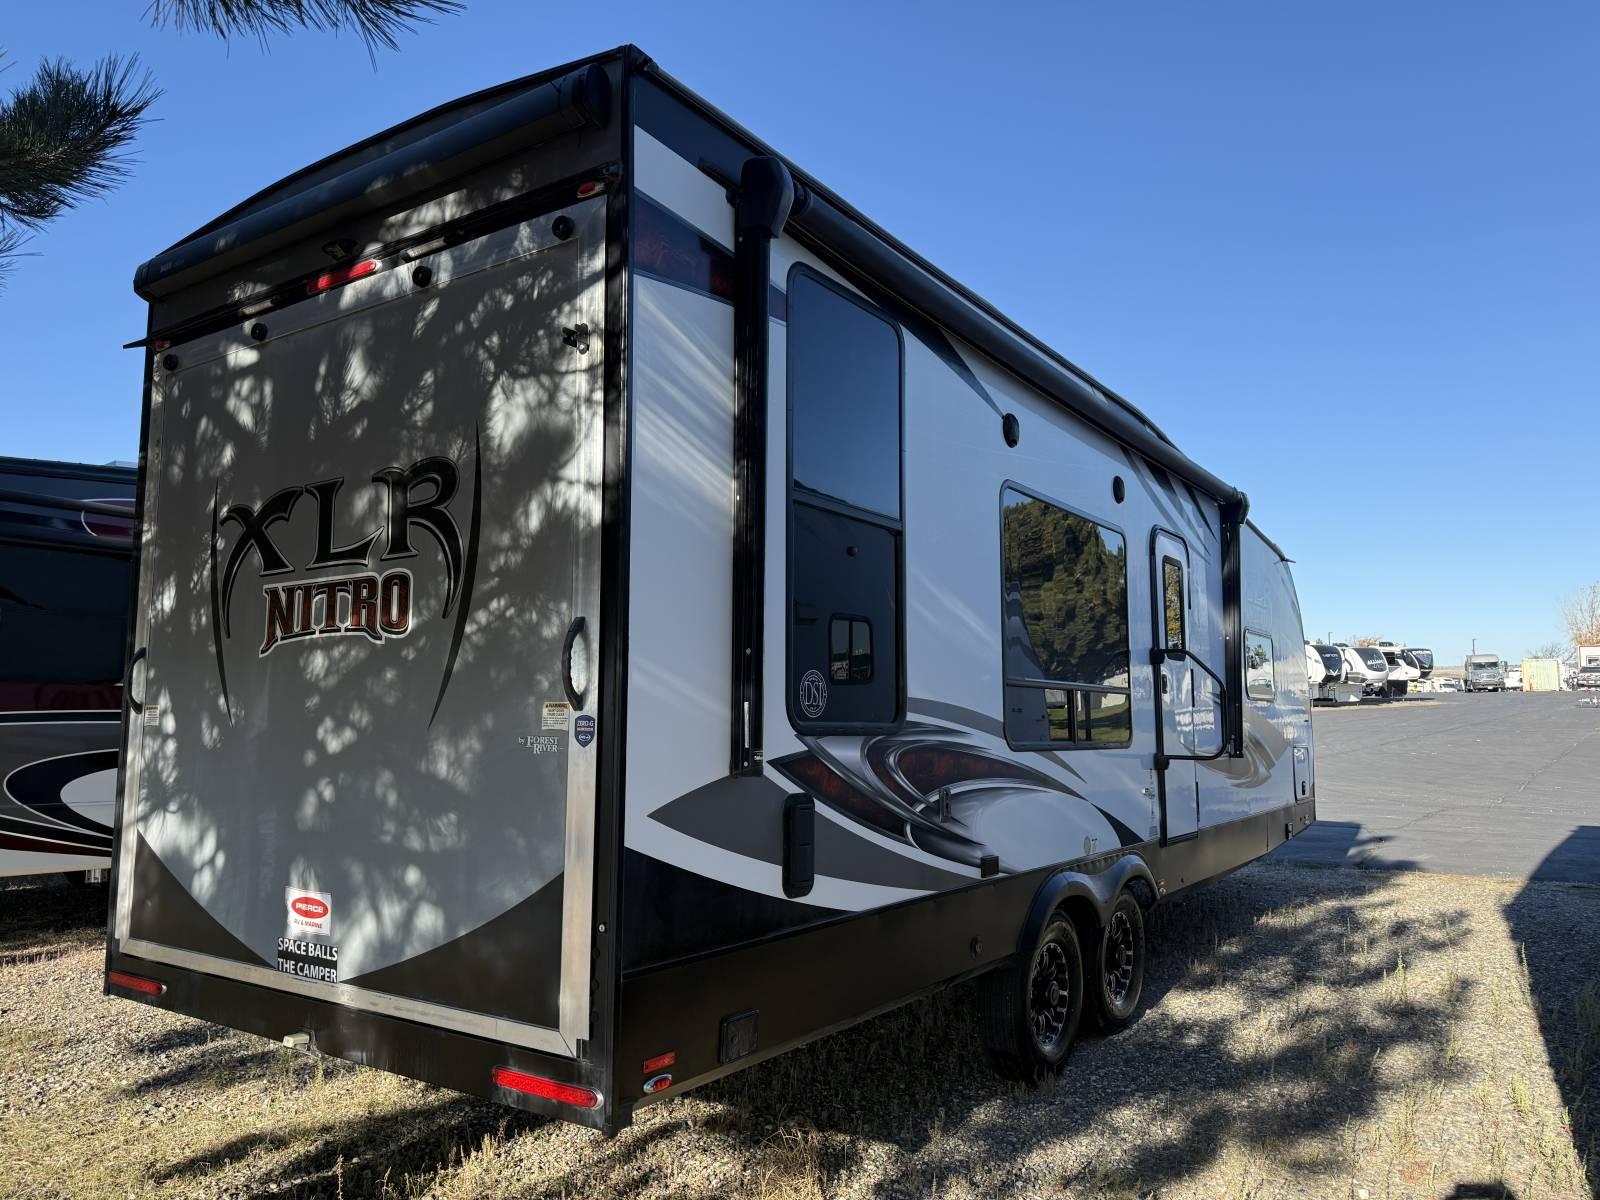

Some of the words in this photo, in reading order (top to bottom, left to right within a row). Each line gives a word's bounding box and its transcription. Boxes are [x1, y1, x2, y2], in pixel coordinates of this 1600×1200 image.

[220, 456, 464, 639] XLR
[258, 568, 414, 658] NITRO
[805, 681, 822, 705] DSI
[526, 735, 558, 748] FOREST
[533, 743, 558, 754] RIVER
[295, 902, 323, 912] PIERCE
[304, 920, 322, 929] MARINE
[278, 938, 307, 955] SPACE
[308, 943, 338, 961] BALLS
[278, 958, 296, 973] THE
[297, 962, 337, 983] CAMPER
